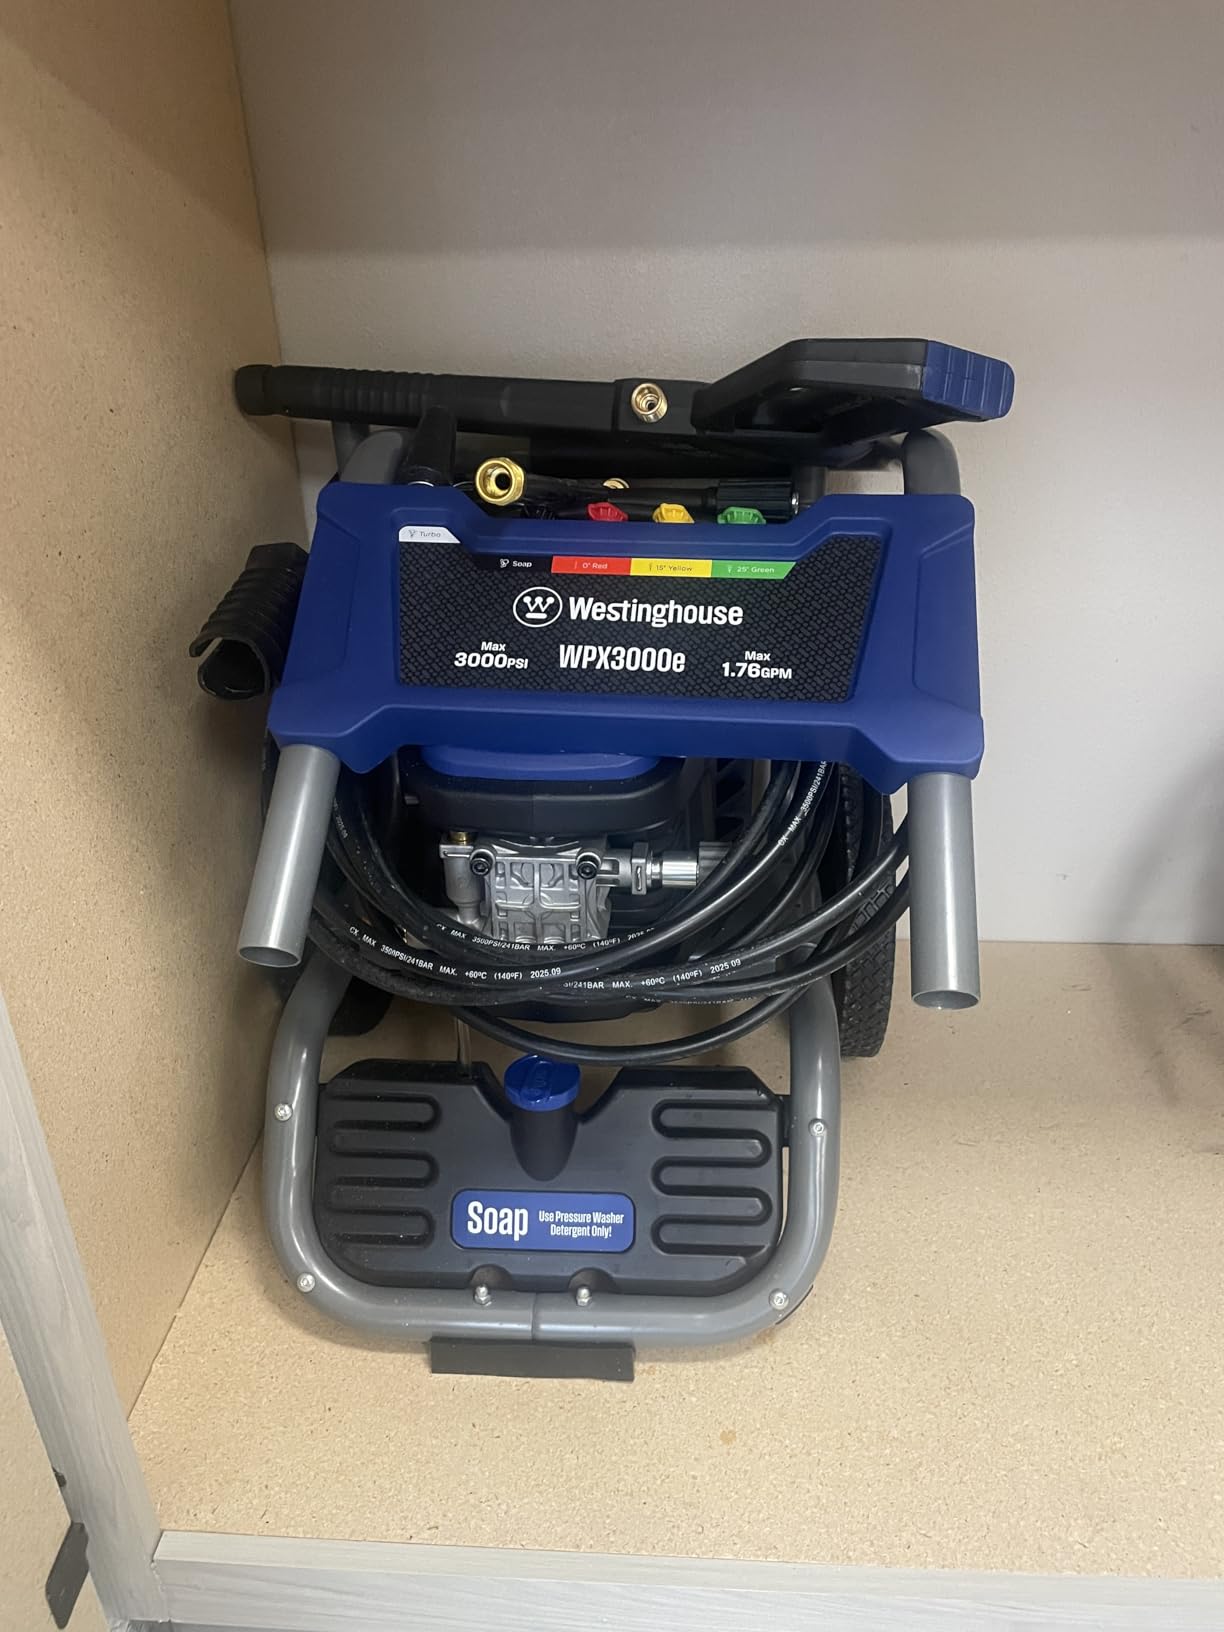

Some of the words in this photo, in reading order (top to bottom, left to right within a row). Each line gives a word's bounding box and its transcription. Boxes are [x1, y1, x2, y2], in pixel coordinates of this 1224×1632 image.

[512, 560, 533, 568] Soap
[751, 566, 775, 574] Green
[569, 596, 744, 628] Westinghouse
[480, 641, 506, 652] Max
[454, 652, 529, 670] 3000PSI
[559, 644, 686, 673] WPX3000e
[744, 651, 771, 662] Max
[722, 662, 793, 680] 1.76GPM
[788, 816, 802, 832] MAX
[450, 929, 467, 940] MAX
[349, 926, 360, 936] CX
[362, 934, 377, 947] MAX
[439, 965, 458, 976] MAX.
[530, 967, 561, 979] 2025.09
[612, 981, 633, 989] MAX.
[467, 1201, 529, 1241] Soap
[539, 1210, 554, 1222] Use
[555, 1211, 591, 1224] Pressure
[593, 1212, 624, 1224] Washer
[550, 1224, 590, 1237] Detergent
[592, 1225, 612, 1239] Only!
